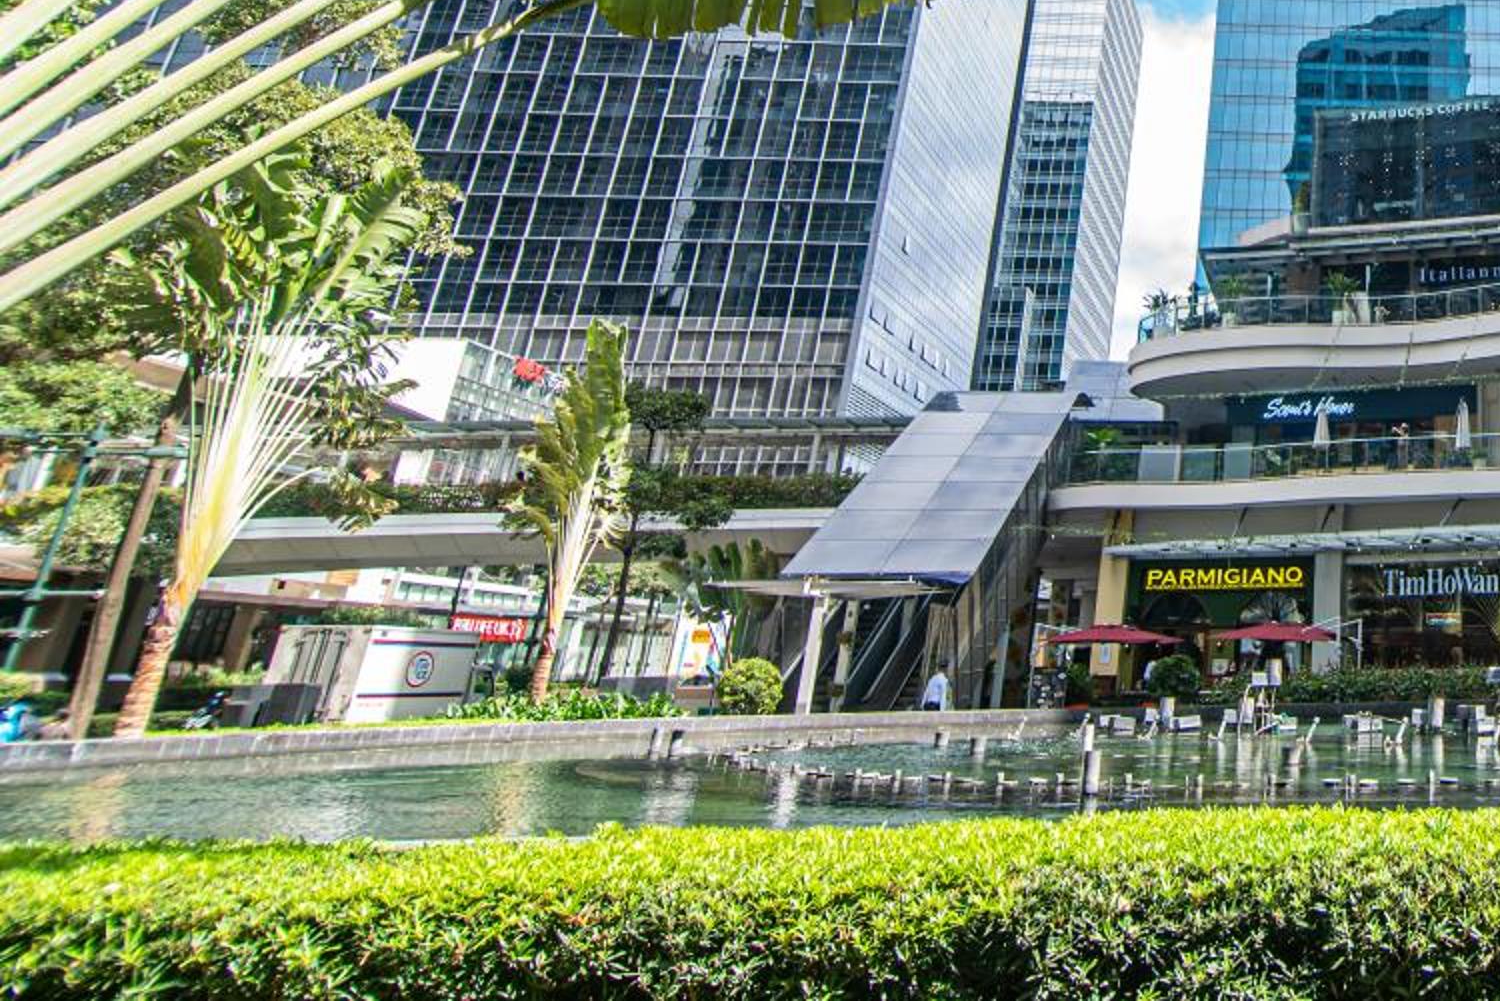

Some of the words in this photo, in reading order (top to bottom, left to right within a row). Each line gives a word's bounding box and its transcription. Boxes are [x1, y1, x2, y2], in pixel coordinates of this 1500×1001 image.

[1351, 107, 1433, 121] STARBUCKS
[1437, 100, 1489, 114] COFFEE
[1146, 566, 1304, 586] PARMIGIANO
